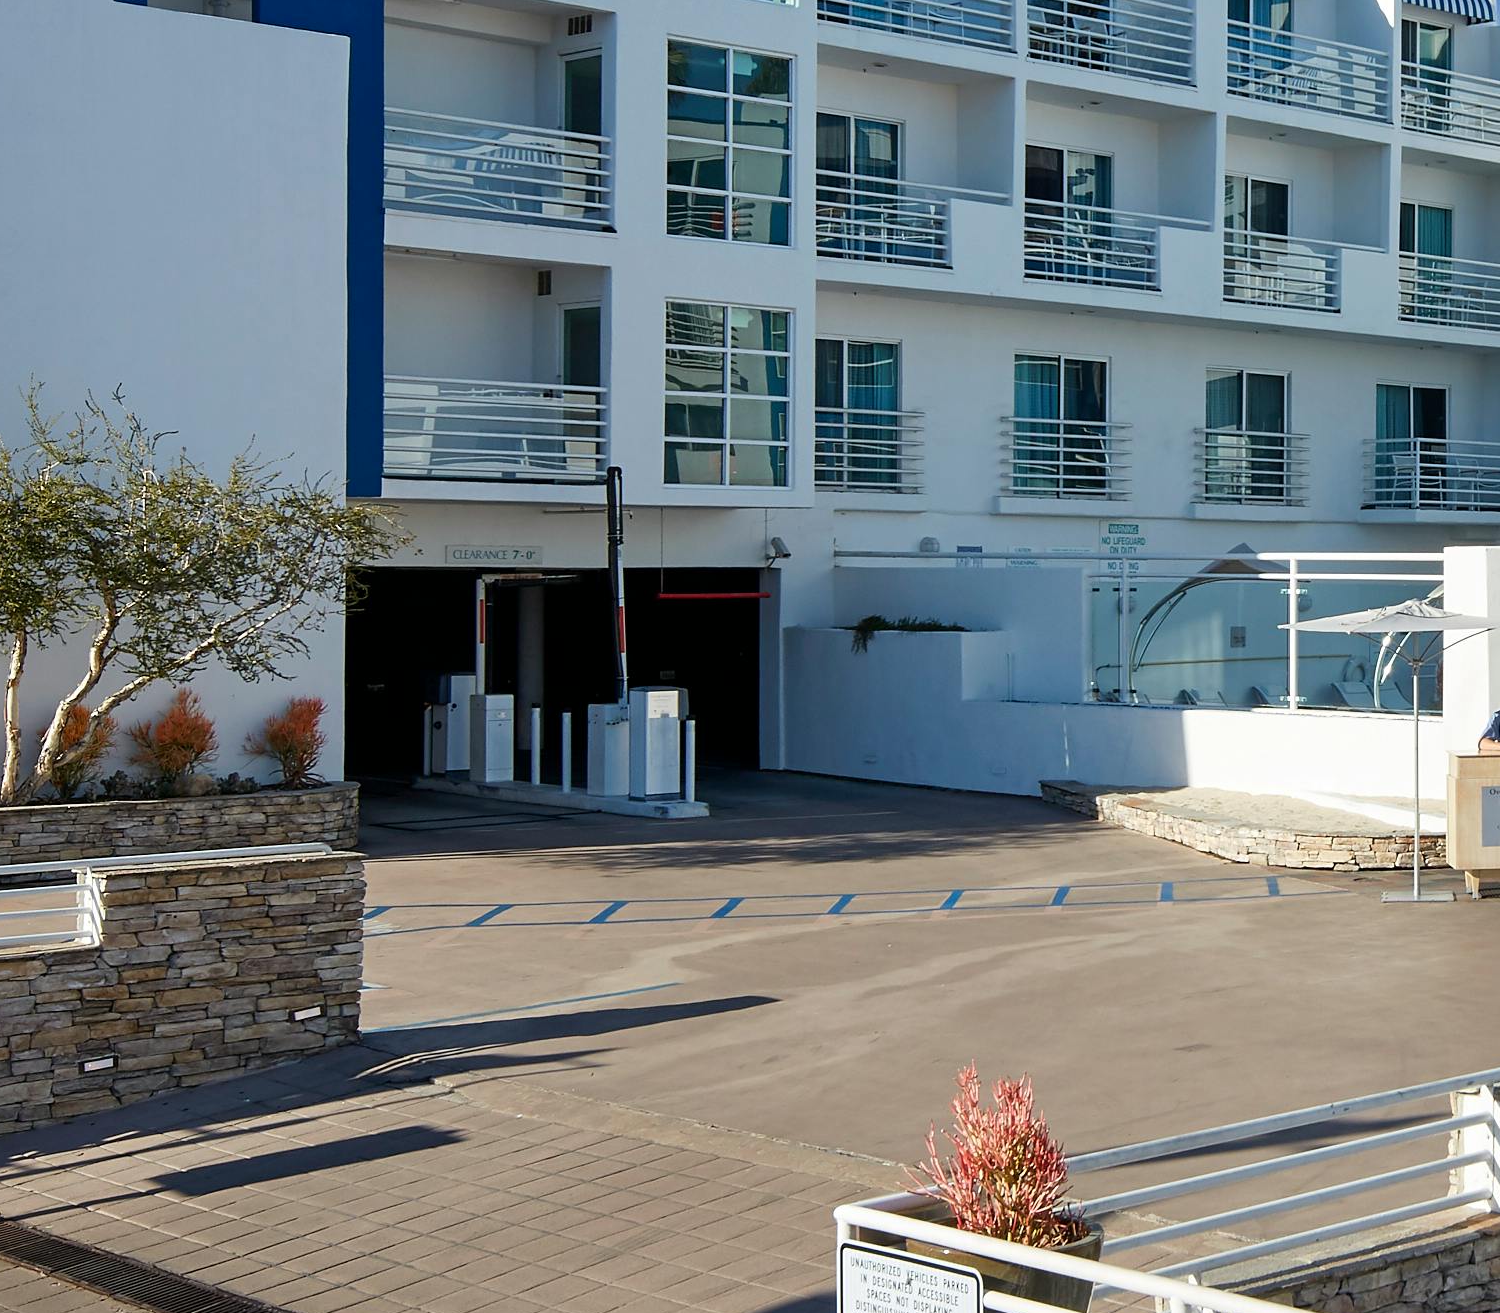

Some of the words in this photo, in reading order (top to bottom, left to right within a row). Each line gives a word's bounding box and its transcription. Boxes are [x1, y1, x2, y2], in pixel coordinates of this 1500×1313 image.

[453, 550, 508, 560] CLEARANCE
[851, 1256, 901, 1277] UNAUTHORIZED
[906, 1270, 938, 1286] VEHICLES
[943, 1278, 969, 1295] PARKED
[860, 1273, 867, 1284] IN
[872, 1275, 913, 1294] DESIGNATED
[918, 1287, 958, 1306] ACCESSIBLE
[867, 1288, 891, 1303] SPACES
[896, 1296, 908, 1308] NOT
